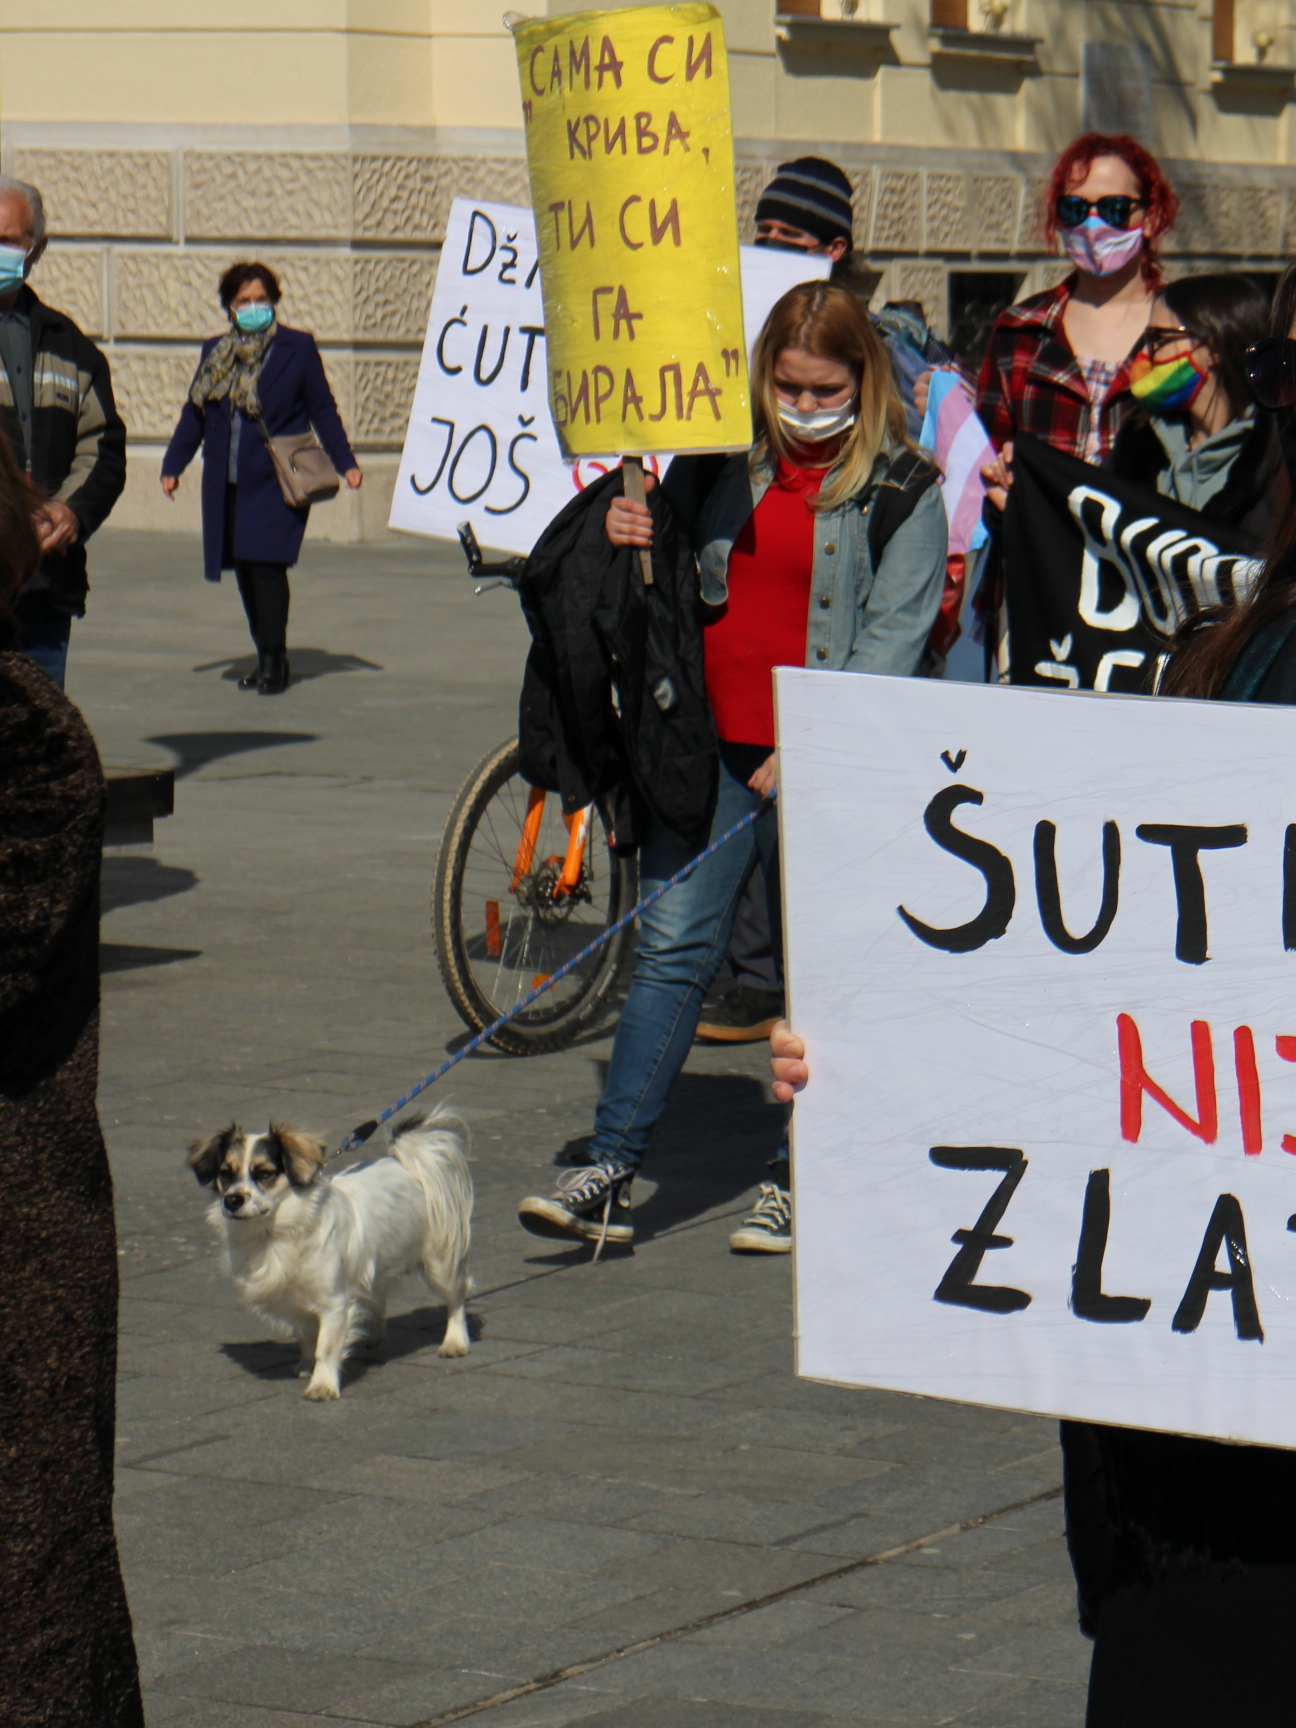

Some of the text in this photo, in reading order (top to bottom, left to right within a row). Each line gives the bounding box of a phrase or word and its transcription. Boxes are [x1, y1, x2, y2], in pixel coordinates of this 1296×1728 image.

[647, 31, 712, 85] СИ
[566, 110, 711, 166] КРИВА,
[548, 194, 682, 252] ТИ СИ
[591, 284, 643, 342] ГА
[410, 414, 538, 515] JOŠ
